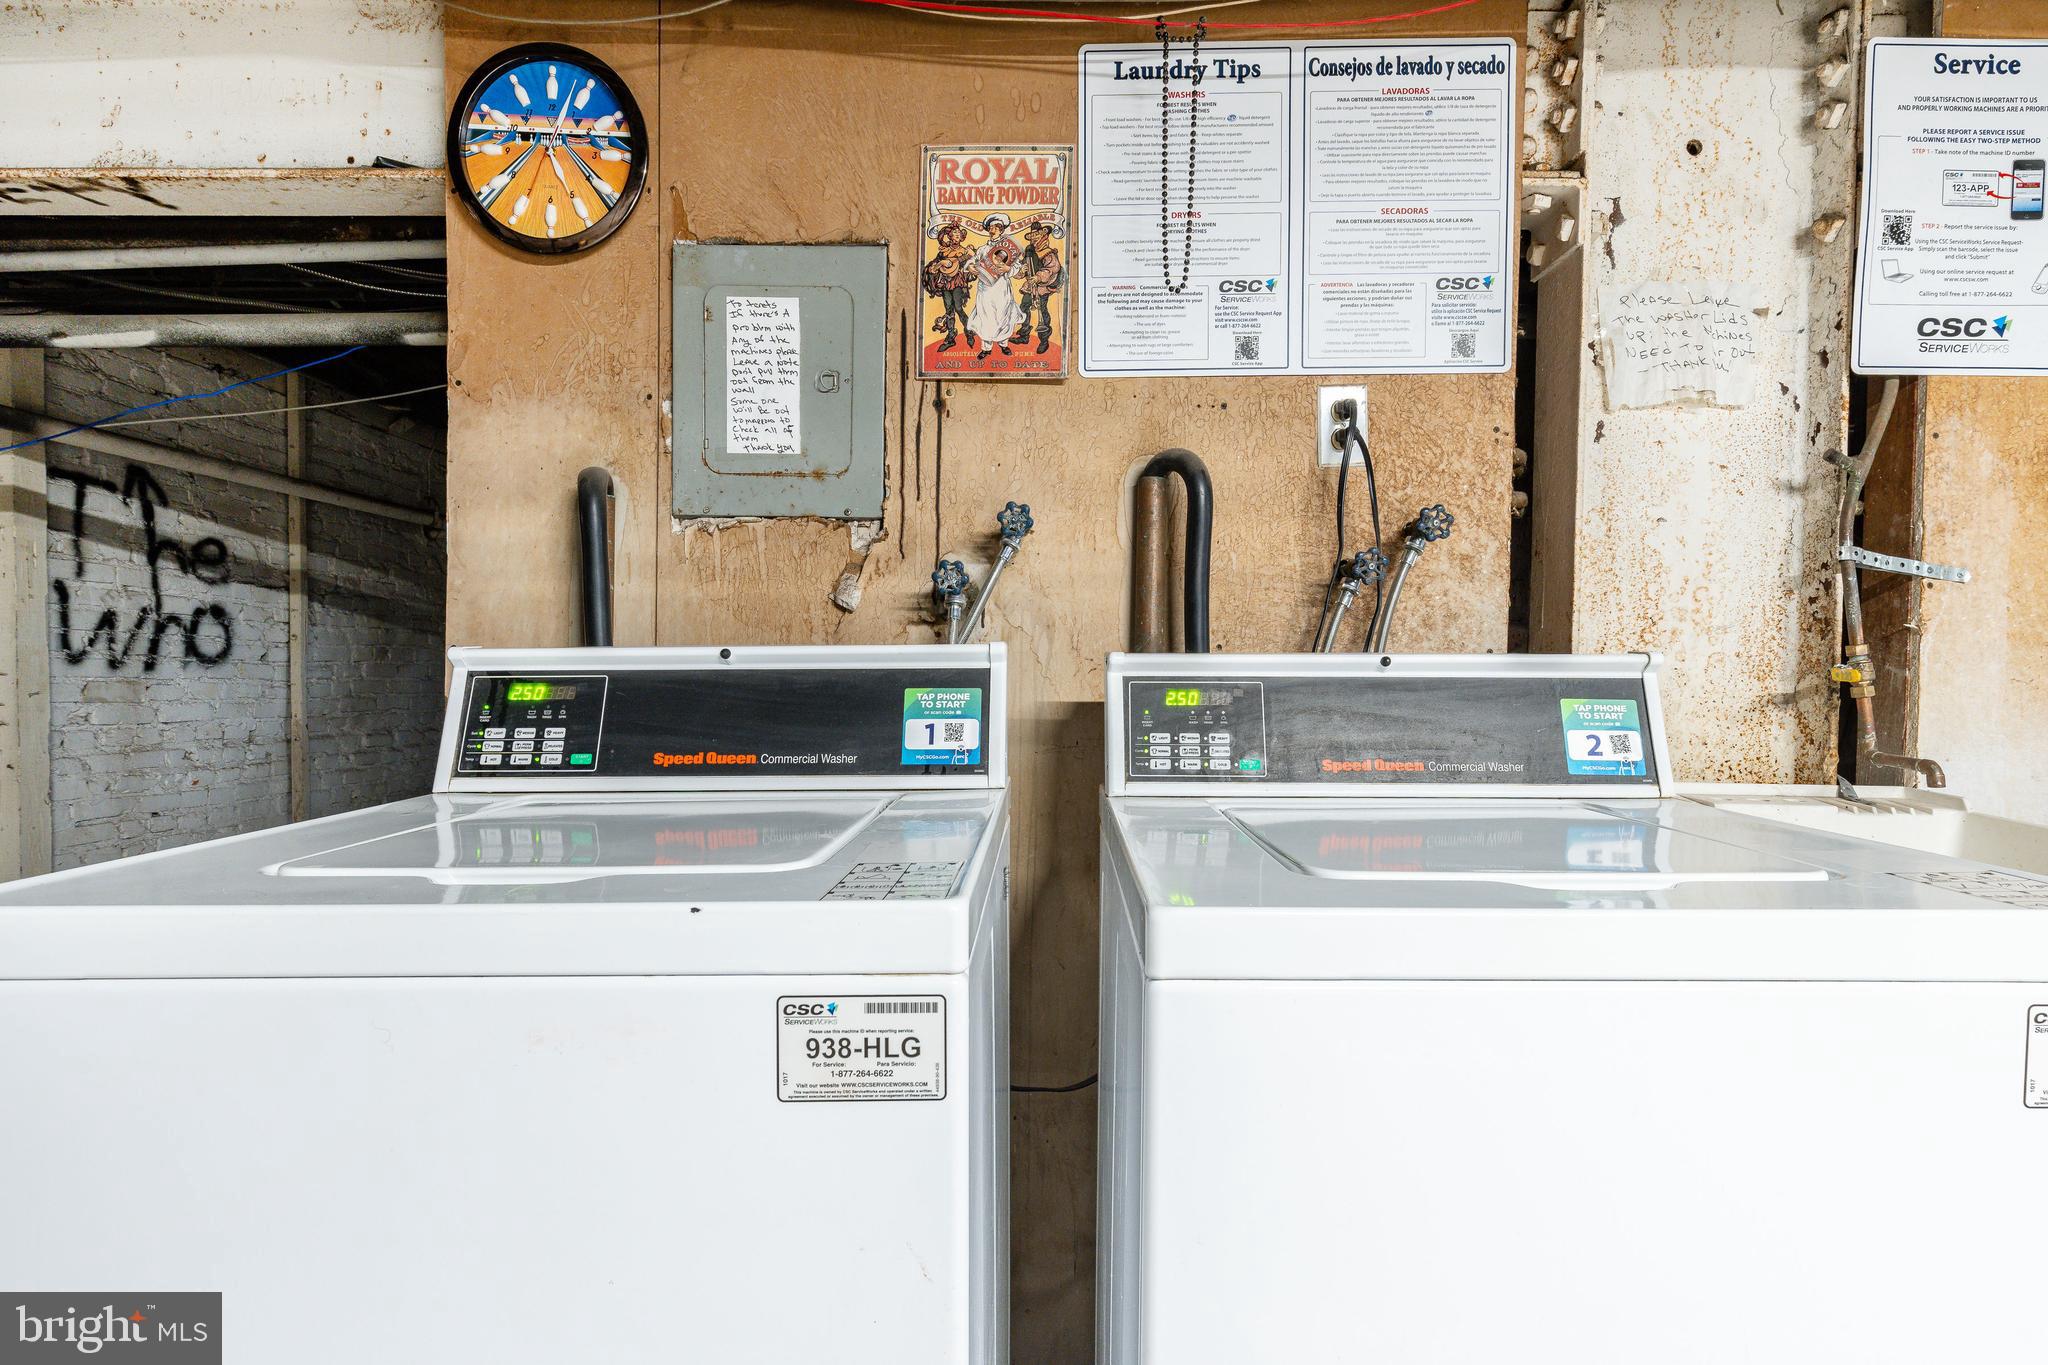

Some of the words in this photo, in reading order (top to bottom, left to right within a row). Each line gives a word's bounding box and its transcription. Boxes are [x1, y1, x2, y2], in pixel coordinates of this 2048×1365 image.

[1309, 57, 1373, 82] Consejos
[1375, 56, 1393, 76] de
[1395, 55, 1443, 76] lavado
[1446, 61, 1455, 80] y
[1457, 54, 1505, 75] secado
[1933, 53, 2021, 75] Service
[1114, 59, 1208, 85] Laundry
[1213, 59, 1261, 84] Tips
[1381, 87, 1431, 95] LAVADORAS
[526, 109, 533, 117] 11
[592, 151, 598, 159] 3
[936, 158, 1058, 185] ROYAL
[527, 188, 532, 196] 7
[570, 190, 574, 199] 5
[1952, 184, 1989, 193] 123-APP
[937, 187, 995, 206] BAKING
[996, 186, 1060, 205] POWDER
[941, 214, 963, 225] THE
[965, 220, 984, 233] OLD
[1009, 213, 1056, 232] RELIABLE
[1218, 280, 1263, 293] CSC
[1435, 277, 1480, 290] CSC
[1917, 317, 1988, 338] CSC
[935, 360, 962, 370] AND
[969, 360, 985, 369] UP
[991, 360, 1009, 369] TO
[1013, 360, 1050, 369] DATE
[511, 686, 545, 700] 2.50
[917, 693, 935, 701] TAP
[937, 693, 970, 701] PHONE
[1166, 691, 1199, 706] 2.50
[1573, 704, 1592, 712] TAP
[925, 723, 935, 745] 1
[1585, 734, 1603, 756] 2
[653, 752, 704, 767] Speed
[706, 752, 757, 765] Queen
[760, 753, 819, 764] Commercial
[821, 752, 857, 764] Washer
[1322, 759, 1372, 773] Speed
[1375, 758, 1424, 772] Queen
[1428, 760, 1486, 772] Commercial
[1488, 760, 1524, 772] Washer
[783, 1004, 824, 1016] CSC
[806, 1036, 921, 1059] 938-HLG
[831, 1070, 894, 1078] 1-877-264-6622
